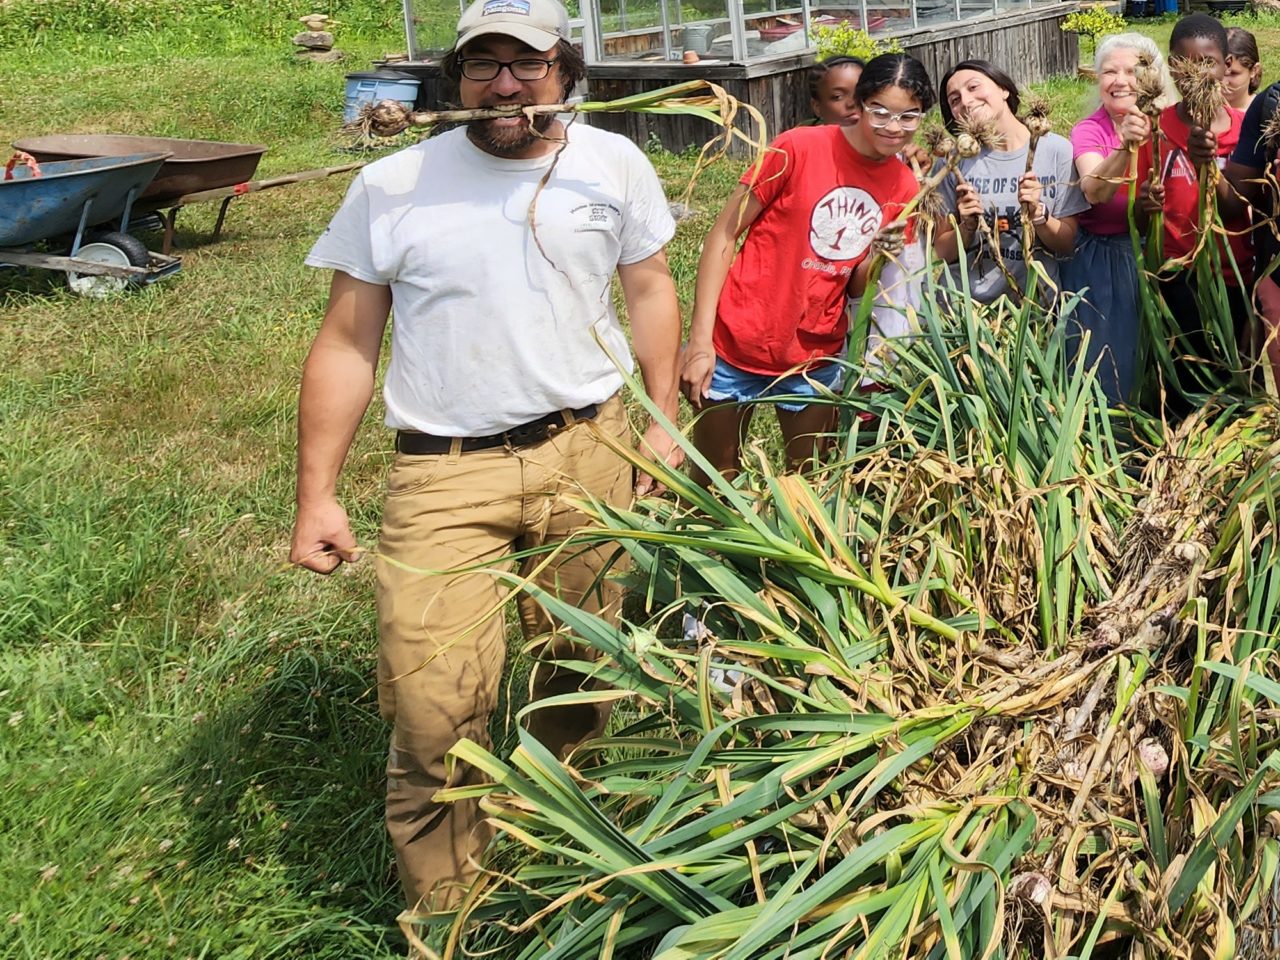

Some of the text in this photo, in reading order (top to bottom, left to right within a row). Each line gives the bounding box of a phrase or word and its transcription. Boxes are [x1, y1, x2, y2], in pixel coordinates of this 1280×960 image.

[992, 177, 1008, 194] OF
[820, 195, 878, 236] THING
[828, 226, 847, 251] 1
